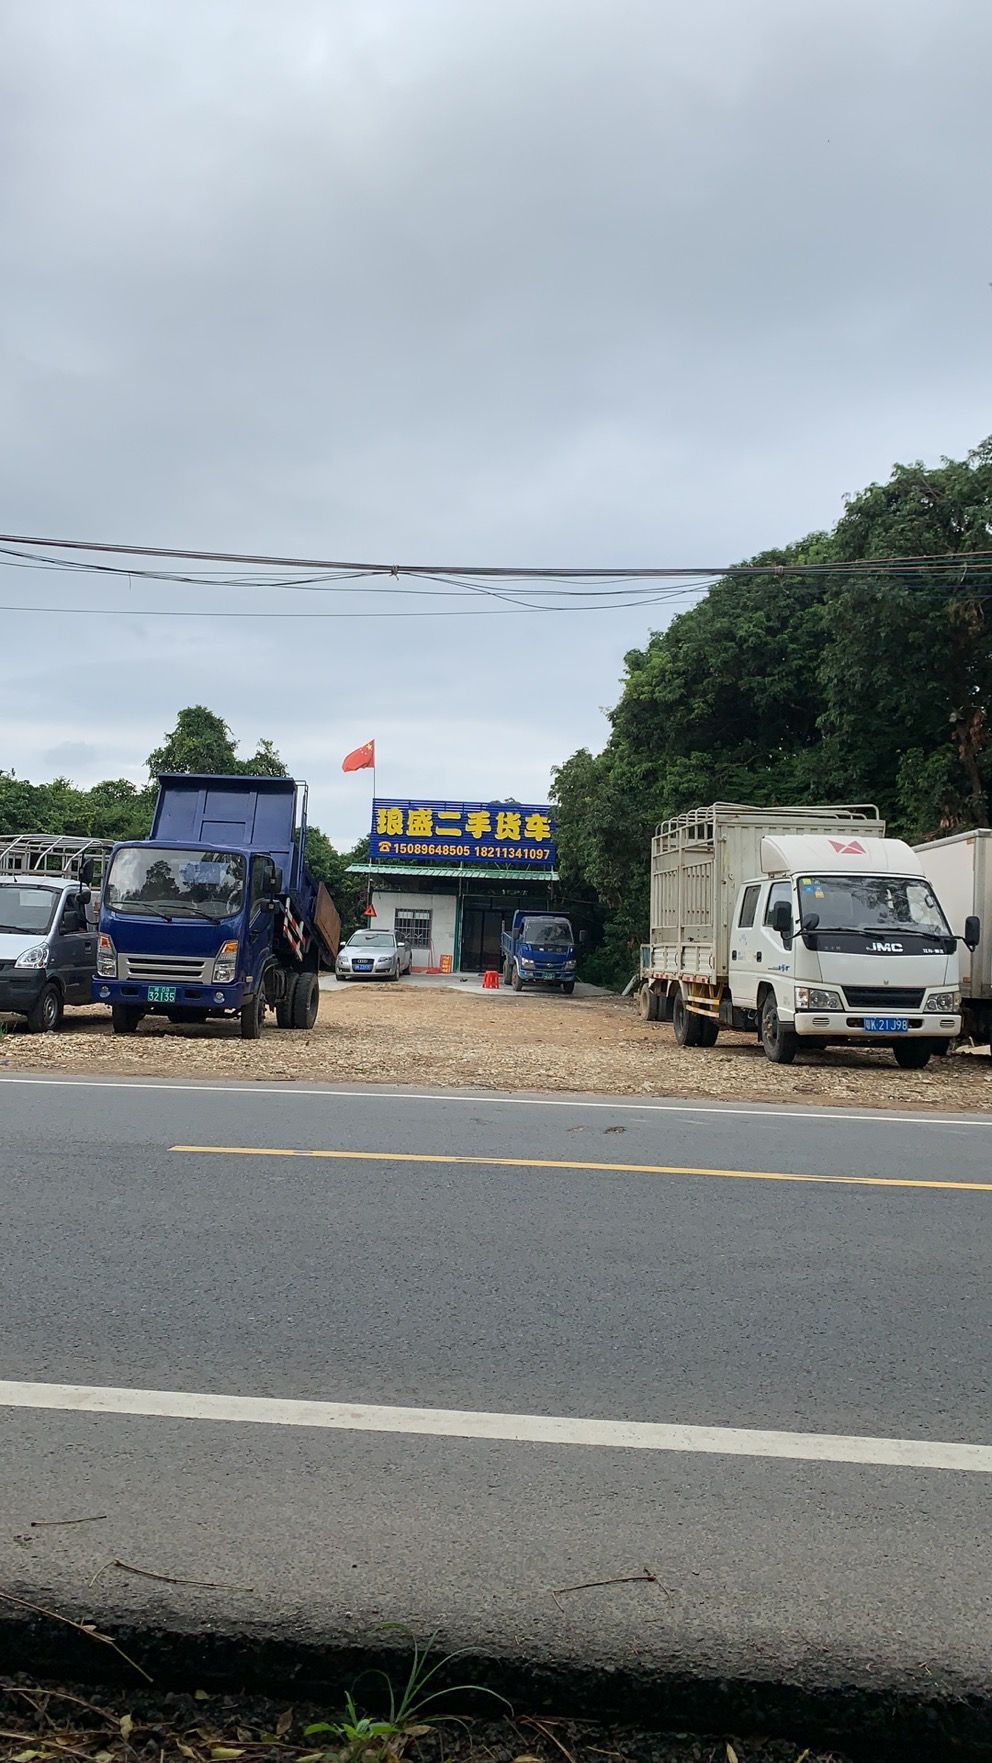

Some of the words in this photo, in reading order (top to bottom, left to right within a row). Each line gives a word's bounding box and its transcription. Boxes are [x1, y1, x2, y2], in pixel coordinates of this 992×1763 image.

[393, 843, 470, 856] 15089648505
[474, 846, 550, 860] 18211341097
[866, 942, 903, 952] JMC
[148, 992, 175, 1001] 32135
